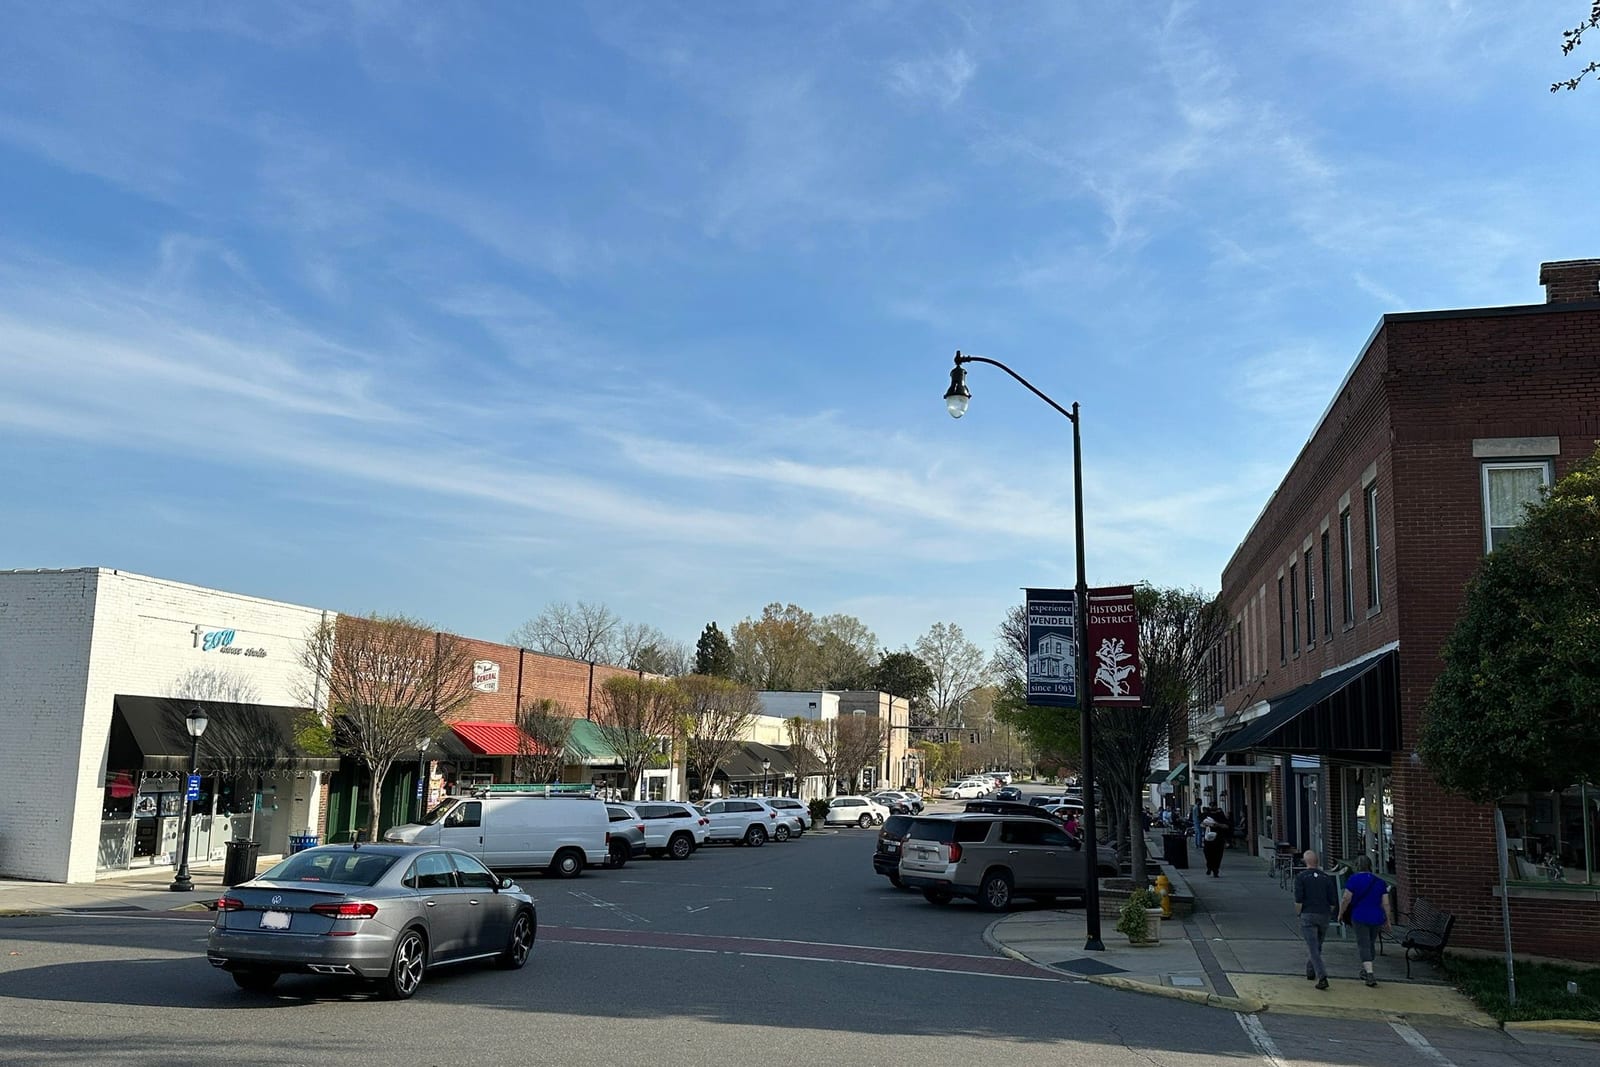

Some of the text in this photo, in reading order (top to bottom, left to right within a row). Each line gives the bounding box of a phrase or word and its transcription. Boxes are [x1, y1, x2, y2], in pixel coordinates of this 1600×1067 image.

[1030, 604, 1072, 613] experience
[1090, 604, 1134, 614] HISTORIC
[1029, 616, 1073, 625] WENDELL
[1090, 615, 1134, 624] DISTRICT
[1031, 683, 1073, 694] since 1903
